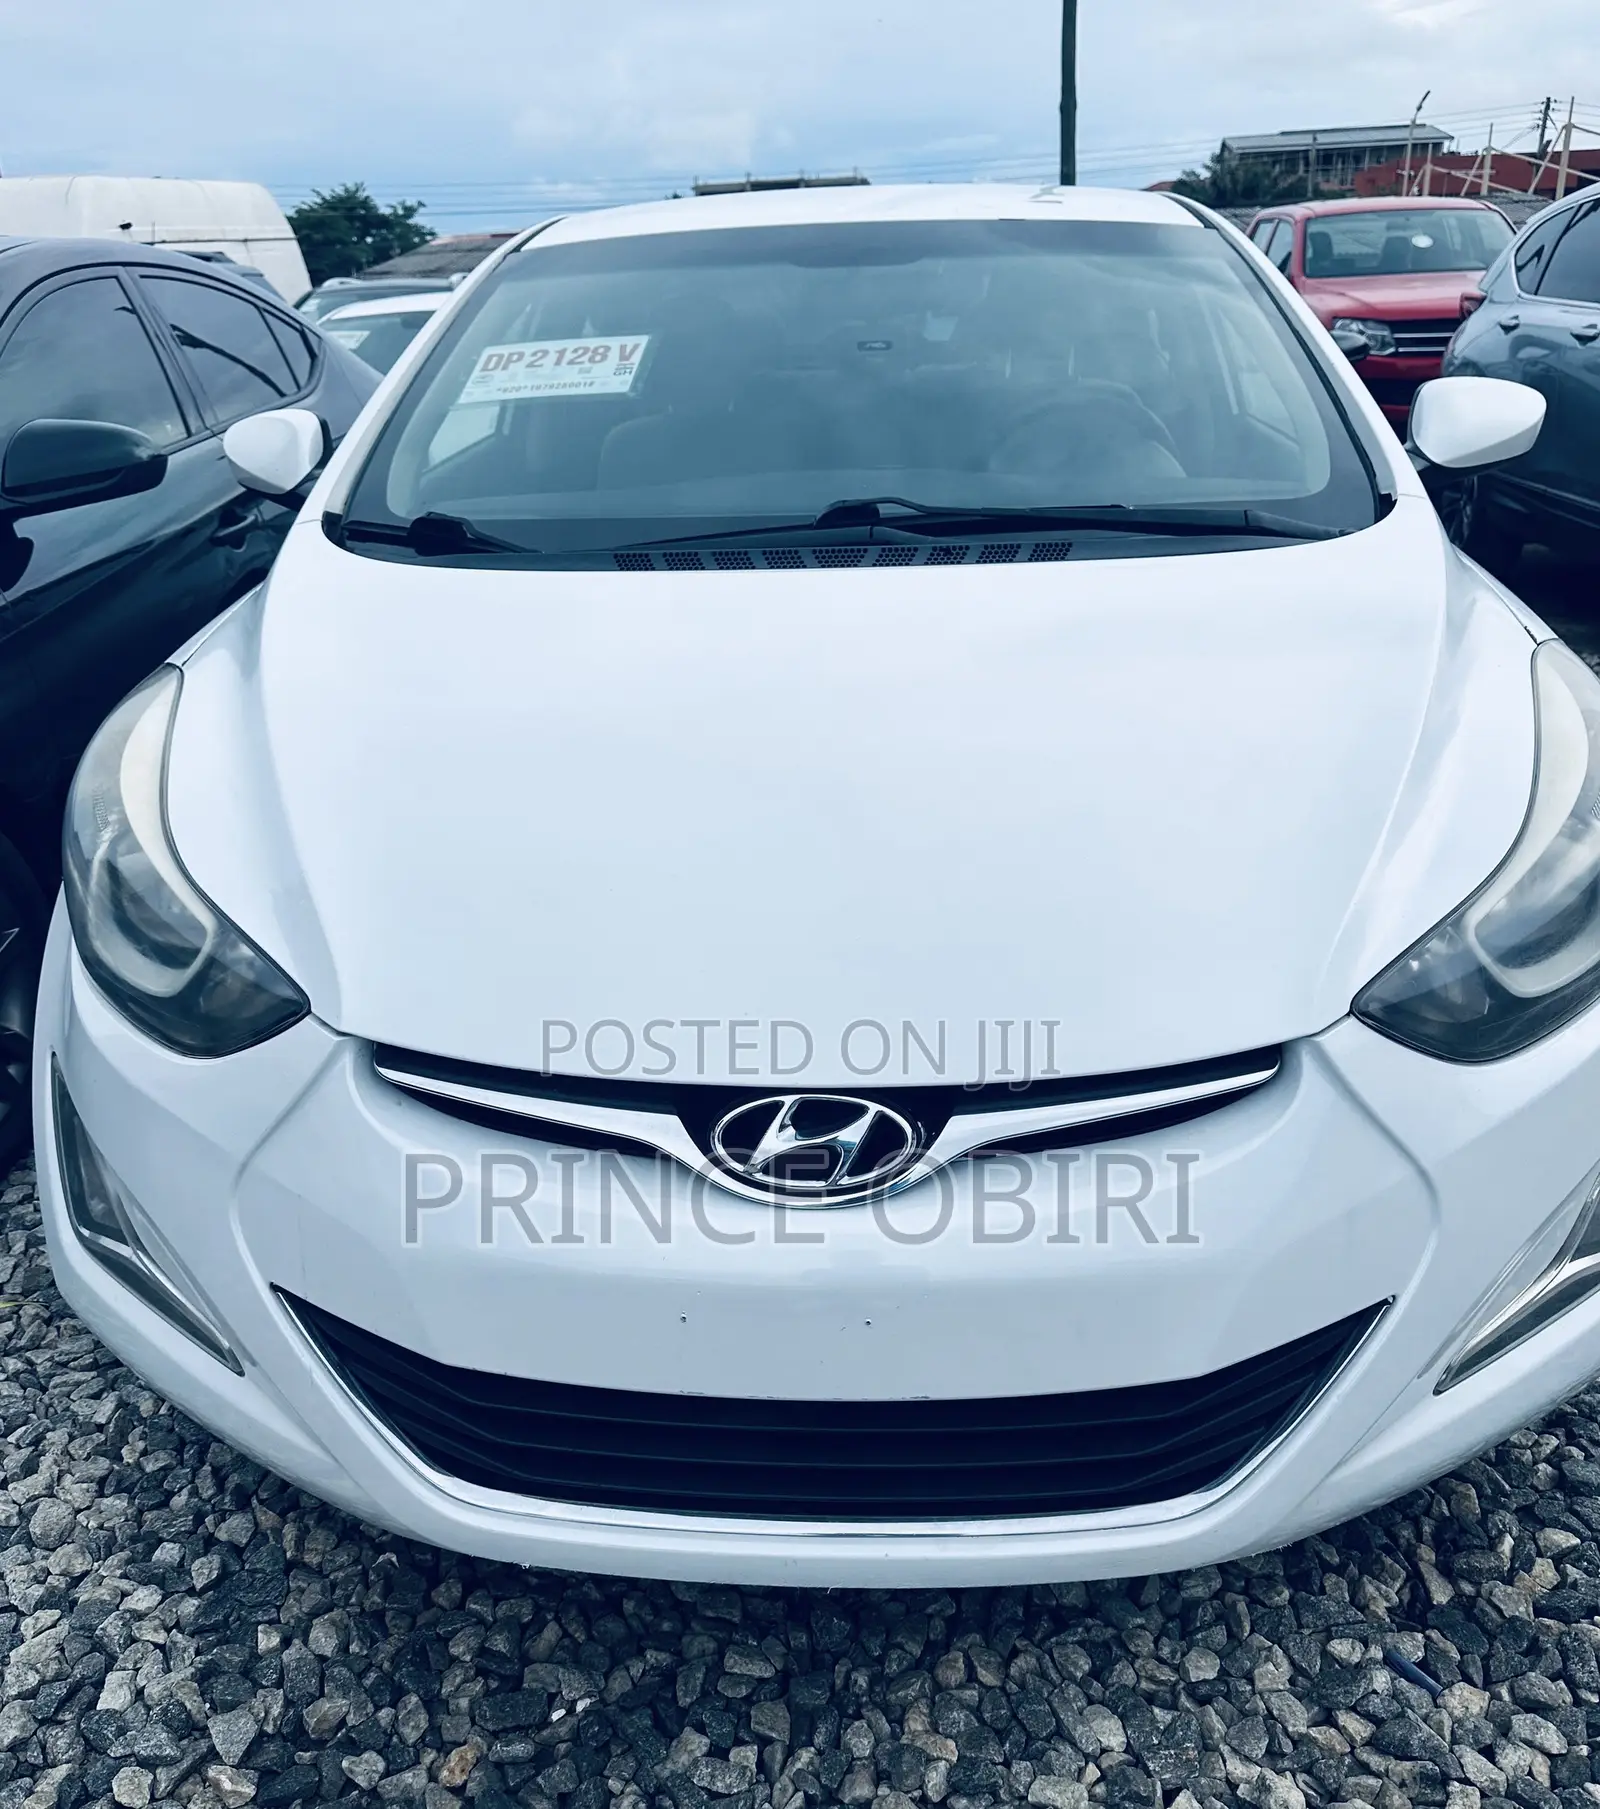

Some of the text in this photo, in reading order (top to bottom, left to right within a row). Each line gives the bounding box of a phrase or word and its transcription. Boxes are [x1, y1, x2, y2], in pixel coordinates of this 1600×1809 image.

[479, 343, 641, 373] DP 2128 V
